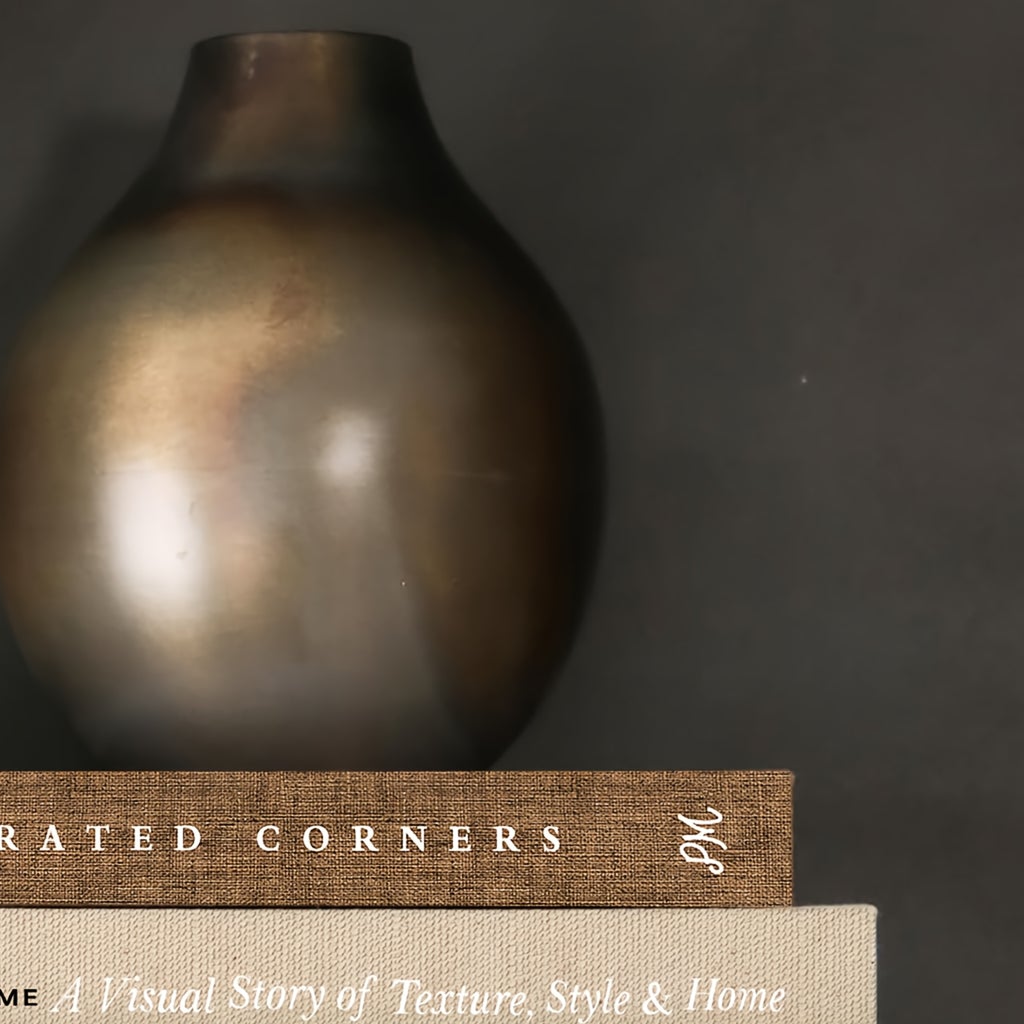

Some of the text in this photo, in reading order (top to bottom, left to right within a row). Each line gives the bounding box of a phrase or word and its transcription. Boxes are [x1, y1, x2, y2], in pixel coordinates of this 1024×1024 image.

[256, 825, 561, 852] CORNERS
[49, 976, 82, 1014] A
[100, 976, 216, 1014] Visual
[229, 974, 326, 1021] Story
[336, 974, 378, 1022] of
[390, 978, 534, 1019] Texture,
[546, 978, 631, 1023] Style
[642, 981, 672, 1016] &
[685, 977, 786, 1013] Home
